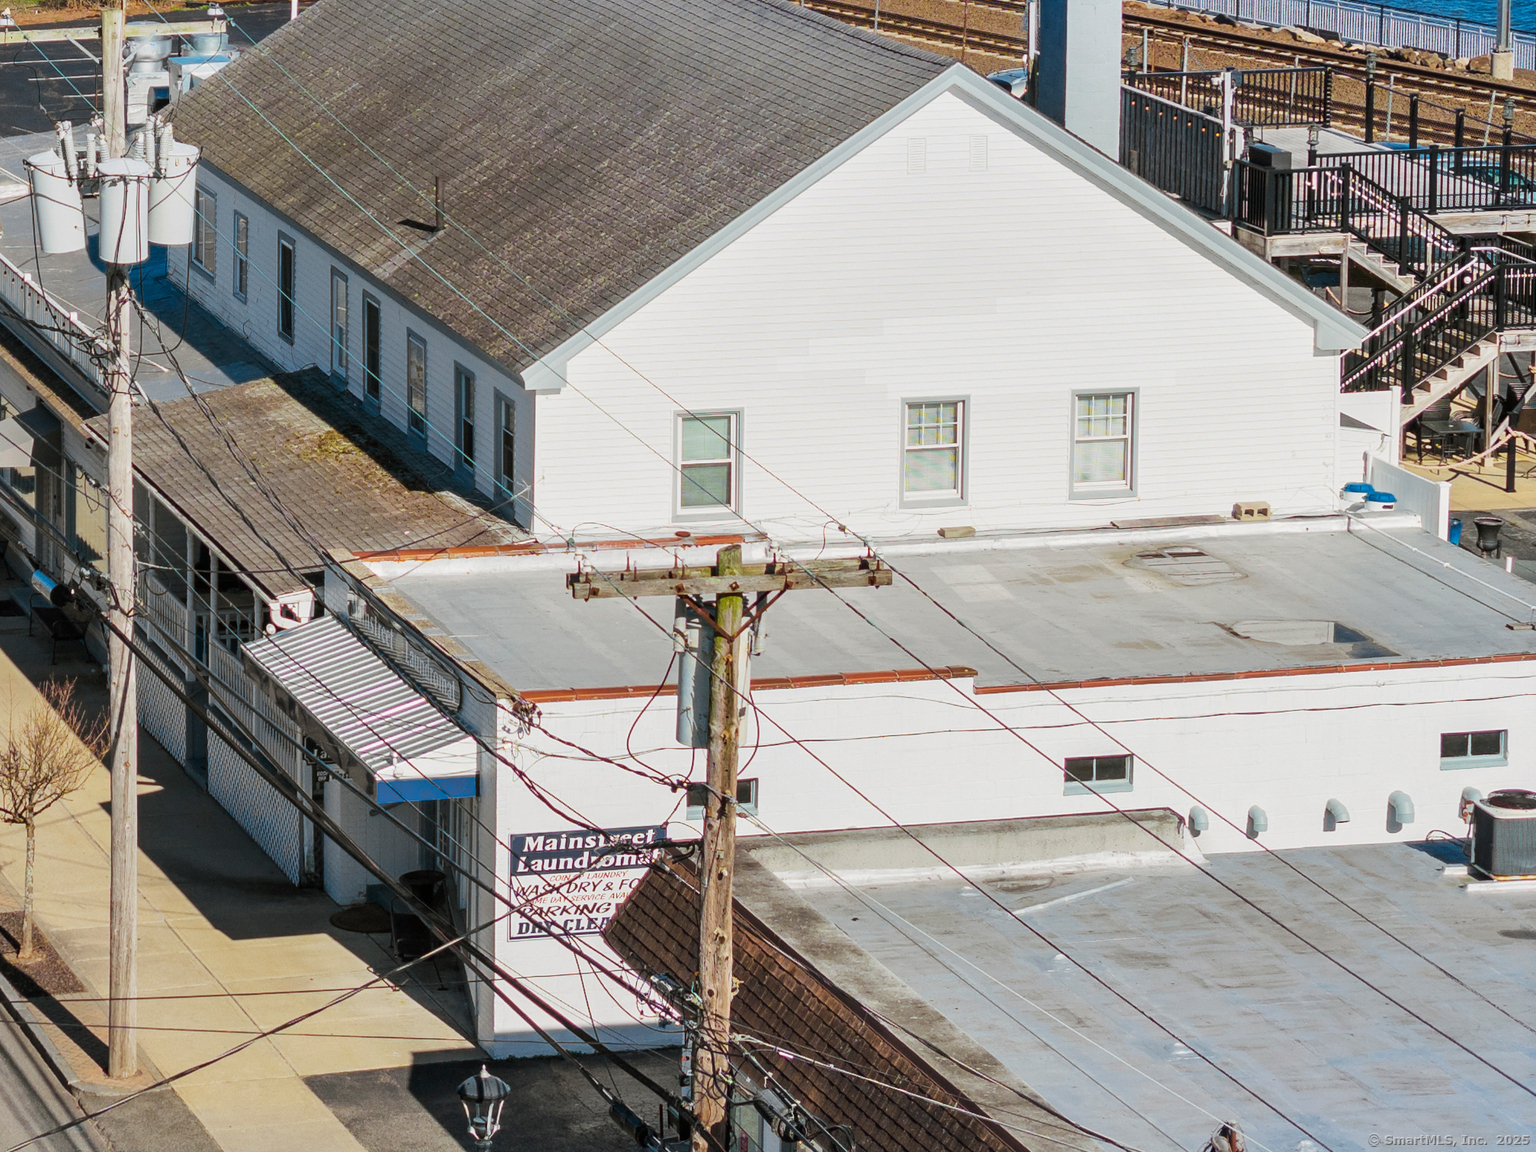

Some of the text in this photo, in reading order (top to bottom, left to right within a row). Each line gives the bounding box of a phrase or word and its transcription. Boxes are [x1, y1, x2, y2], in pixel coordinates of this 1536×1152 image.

[587, 870, 628, 879] LAUNDRY
[566, 879, 603, 894] DRY
[603, 882, 613, 891] &
[520, 902, 612, 918] PARKING
